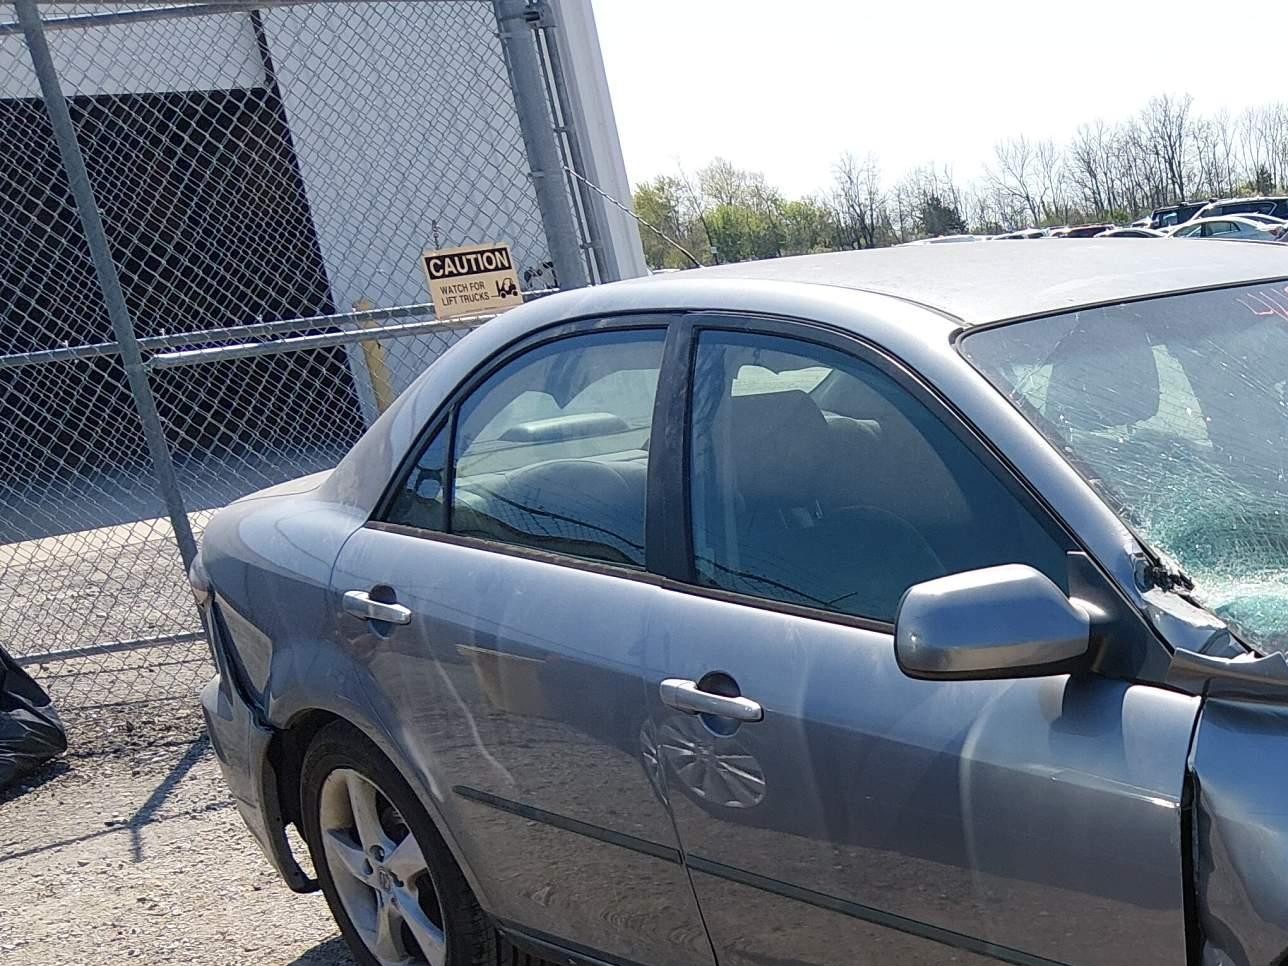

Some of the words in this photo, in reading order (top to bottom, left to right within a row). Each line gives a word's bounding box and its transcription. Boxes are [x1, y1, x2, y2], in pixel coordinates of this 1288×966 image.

[429, 250, 510, 277] CAUTION
[439, 282, 469, 296] WATCH
[469, 281, 486, 293] FOR
[441, 295, 459, 307] LIFT
[459, 291, 490, 304] TRUCKS
